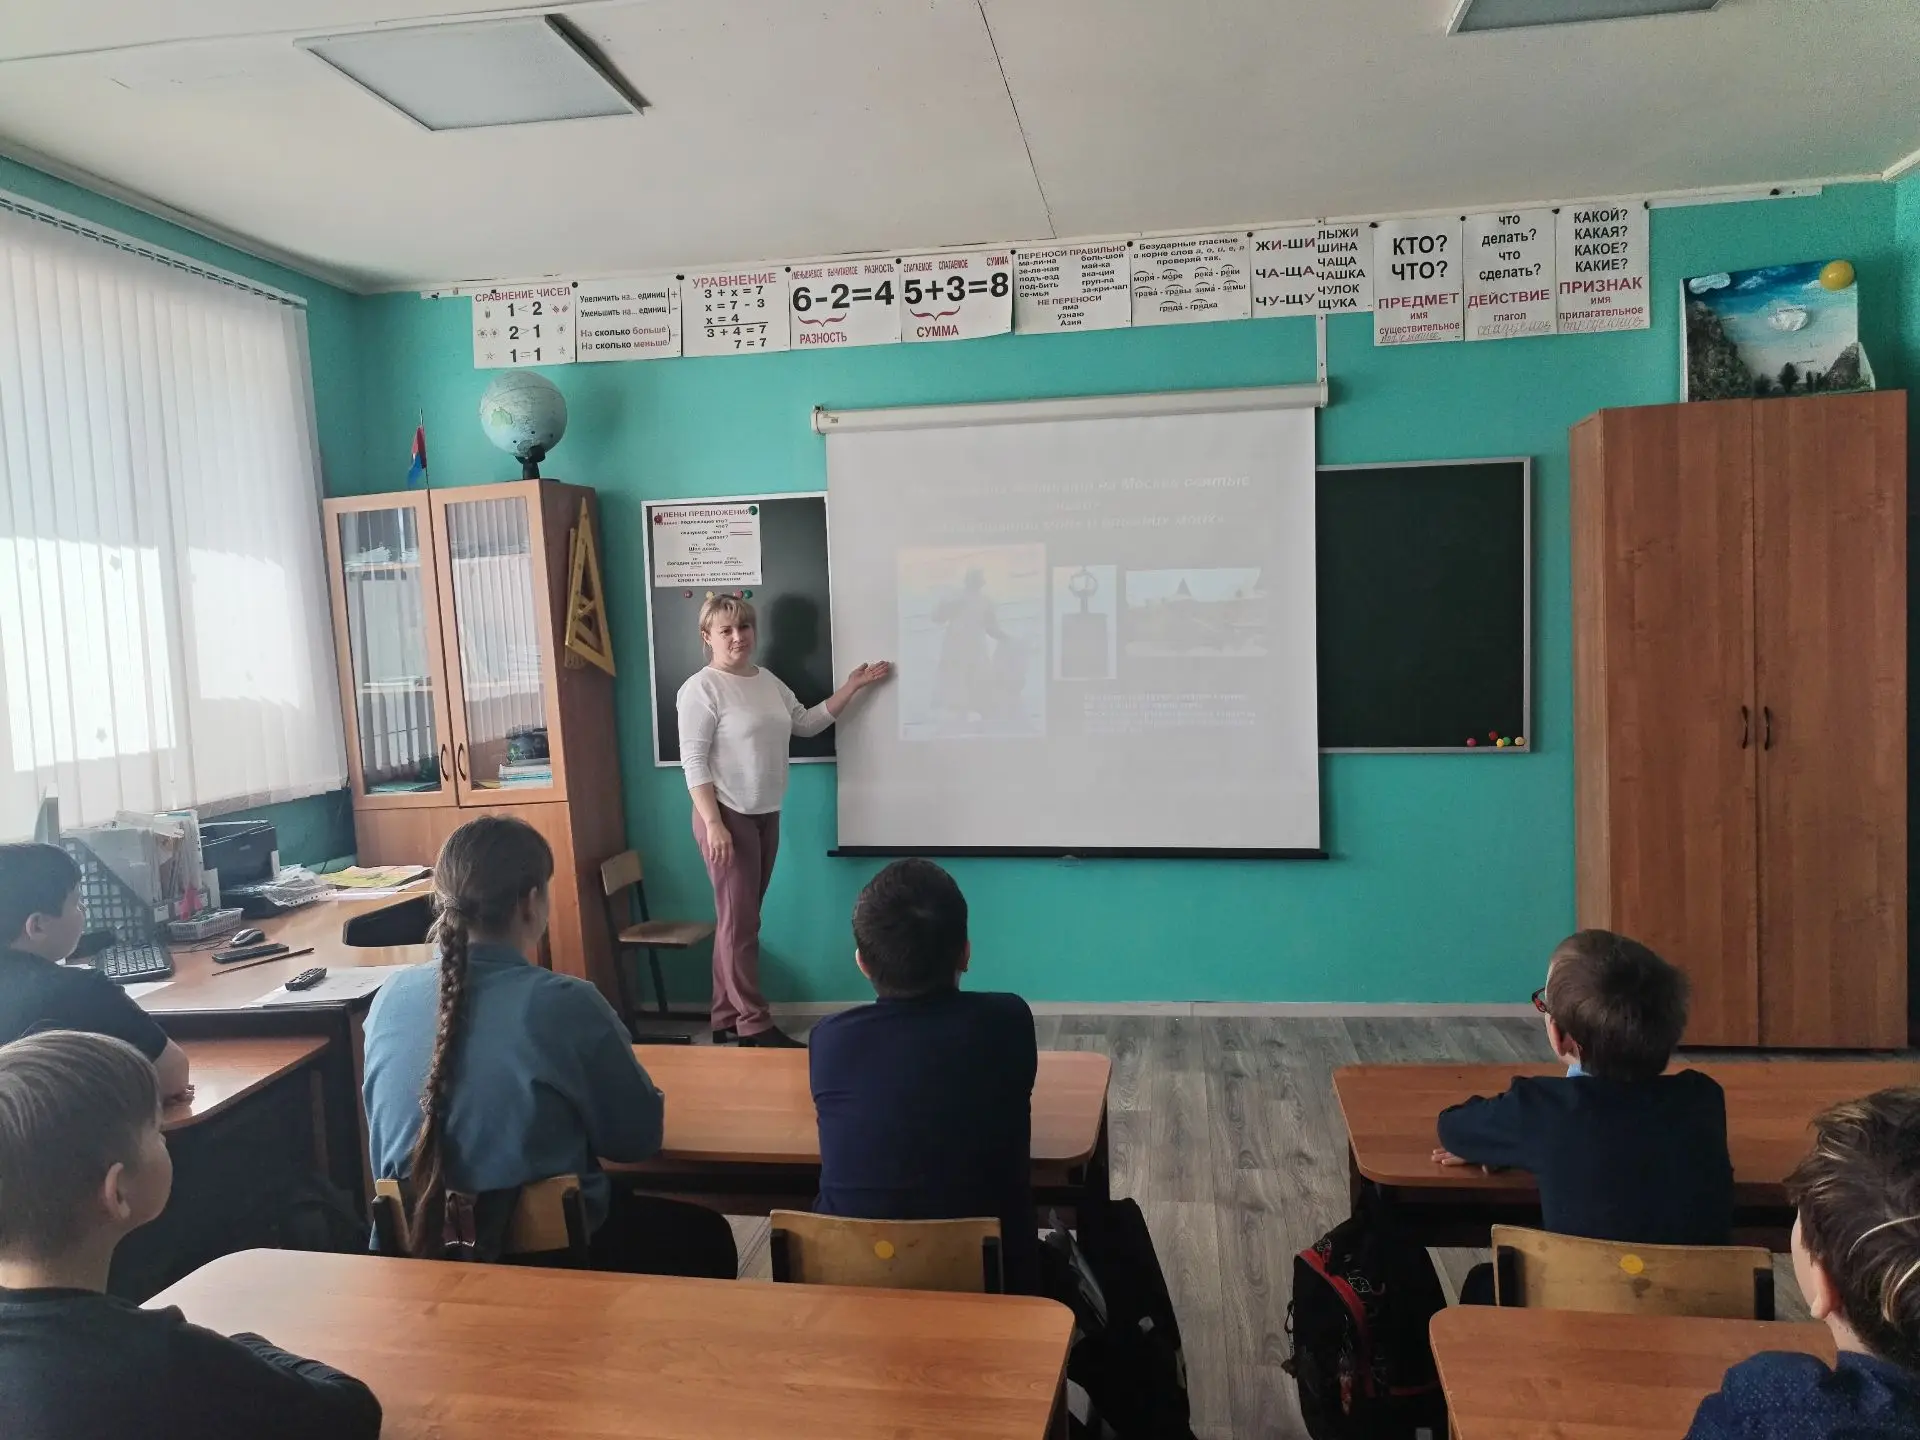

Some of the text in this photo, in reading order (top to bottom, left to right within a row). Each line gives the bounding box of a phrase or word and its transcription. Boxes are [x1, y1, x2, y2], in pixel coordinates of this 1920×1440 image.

[1499, 215, 1520, 225] что
[1574, 207, 1628, 223] КАКОЙ?
[1317, 228, 1358, 240] ЛЫЖИ
[1481, 228, 1537, 247] делать?
[1574, 226, 1628, 240] КАКАЯ?
[1139, 237, 1239, 250] Безударные гласные
[1255, 238, 1315, 251] ЖИ-ШИ
[1317, 242, 1358, 253] ШИНА
[1393, 234, 1448, 255] КТО?
[1574, 242, 1628, 256] КАКОЕ?
[1018, 245, 1126, 260] ПЕРЕНОСИ ПРАВИЛЬНО
[1141, 251, 1168, 259] корне
[1499, 250, 1520, 260] что
[986, 256, 1009, 266] СУММА
[1317, 256, 1357, 267] ЧАЩА
[1575, 258, 1628, 272] КАКИЕ?
[864, 264, 895, 274] РАЗНОСТЬ
[1255, 266, 1315, 278] ЧА-ЩА
[1316, 269, 1366, 280] ЧАШКА
[1391, 260, 1448, 280] ЧТО?
[1479, 263, 1541, 281] сделать?
[692, 273, 776, 289] УРАВНЕНИЕ
[1559, 276, 1643, 295] ПРИЗНАК
[475, 287, 570, 303] СРАВНЕНИЕ ЧИСЕЛ
[704, 289, 712, 299] 3
[756, 285, 764, 295] 7
[1317, 284, 1360, 295] ЧУЛОК
[580, 295, 620, 303] Увеличить
[637, 291, 666, 300] единиц
[1052, 295, 1102, 305] ПЕРЕНОСИ
[1255, 293, 1315, 306] ЧУ-ЩУ
[1378, 292, 1459, 309] ПРЕДМЕТ
[1467, 289, 1550, 309] ДЕЙСТВИЕ
[730, 301, 738, 310] 7
[757, 298, 765, 308] 3
[1318, 298, 1357, 310] ЩУКА
[580, 309, 620, 318] Уменьшить
[638, 306, 667, 315] единиц
[1057, 311, 1084, 320] узнаю
[1493, 312, 1527, 322] глагол
[1559, 306, 1644, 321] прилагательное
[731, 314, 740, 323] 4
[580, 326, 666, 337] На сколько больше
[706, 328, 715, 338] 3
[733, 326, 741, 336] 4
[759, 324, 767, 334] 7
[916, 324, 959, 338] СУММА
[1379, 322, 1460, 336] существительное
[733, 339, 742, 349] 7
[759, 337, 767, 348] 7
[799, 331, 848, 344] РАЗНОСТЬ
[581, 339, 667, 350] На сколько меньше
[688, 509, 751, 517] ПРЕДЛОЖЕНИЯ
